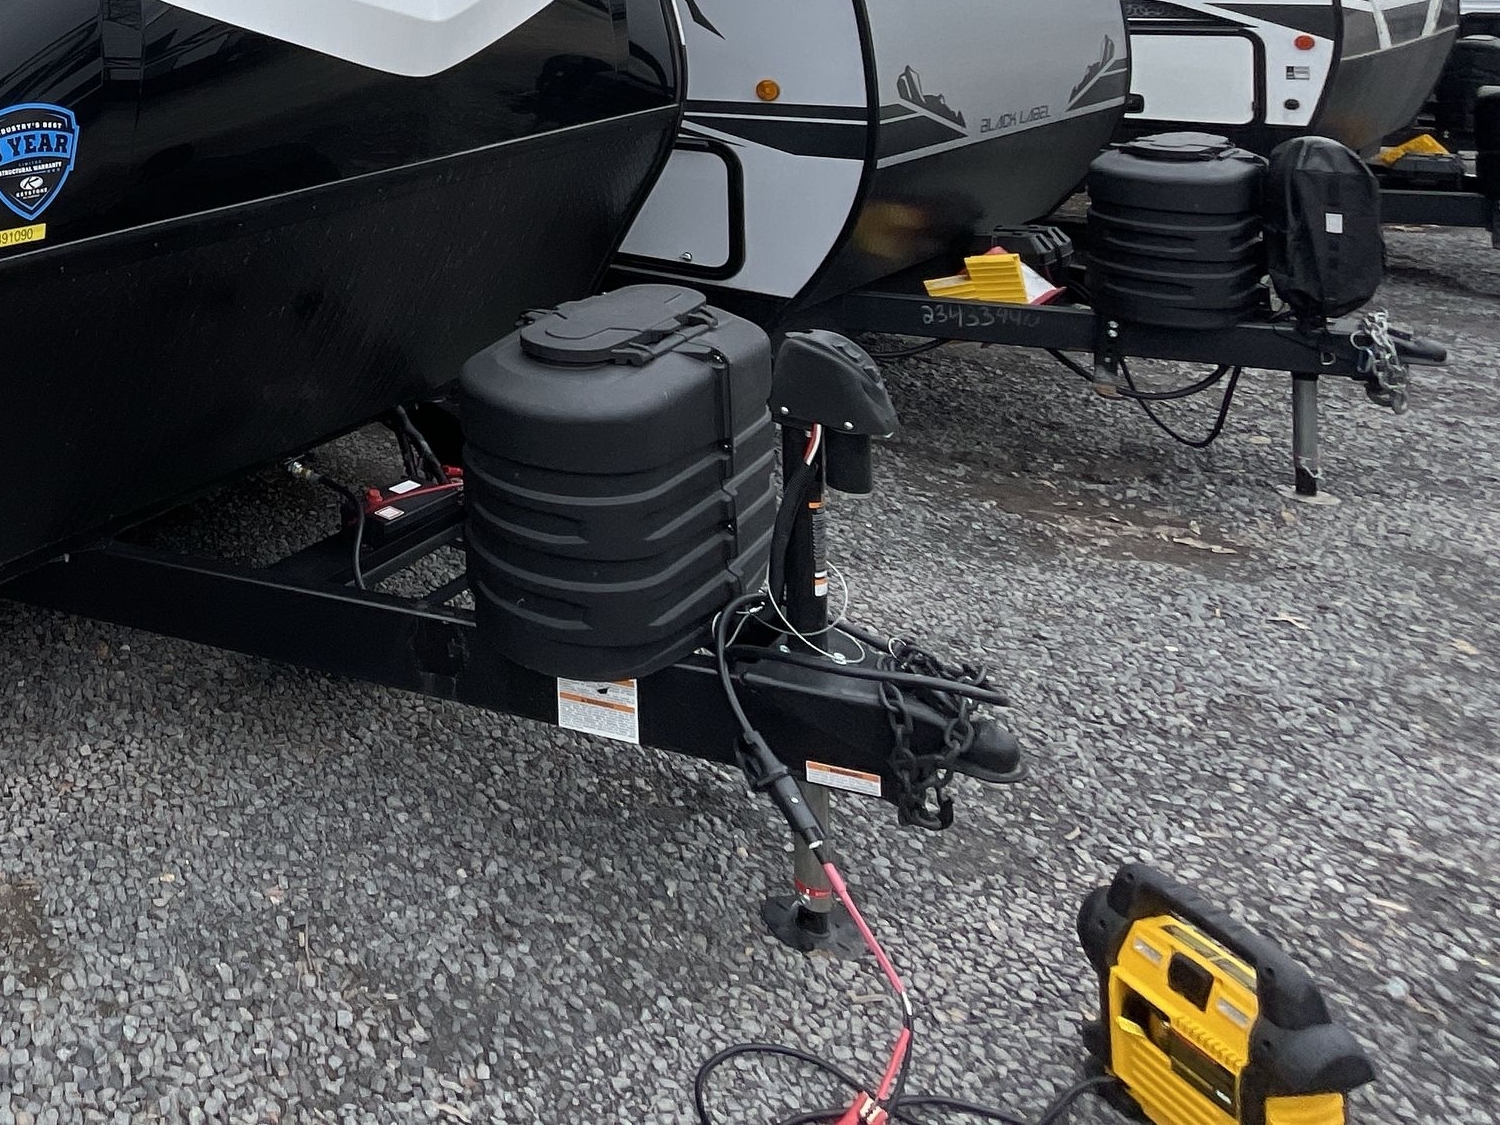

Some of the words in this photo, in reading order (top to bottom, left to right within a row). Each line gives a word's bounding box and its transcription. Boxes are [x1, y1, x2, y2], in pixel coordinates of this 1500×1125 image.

[42, 121, 62, 129] BEST
[980, 112, 1017, 133] BLACK
[1019, 105, 1052, 124] LABEL
[6, 133, 68, 156] YEAR
[32, 161, 62, 171] WARRANTY
